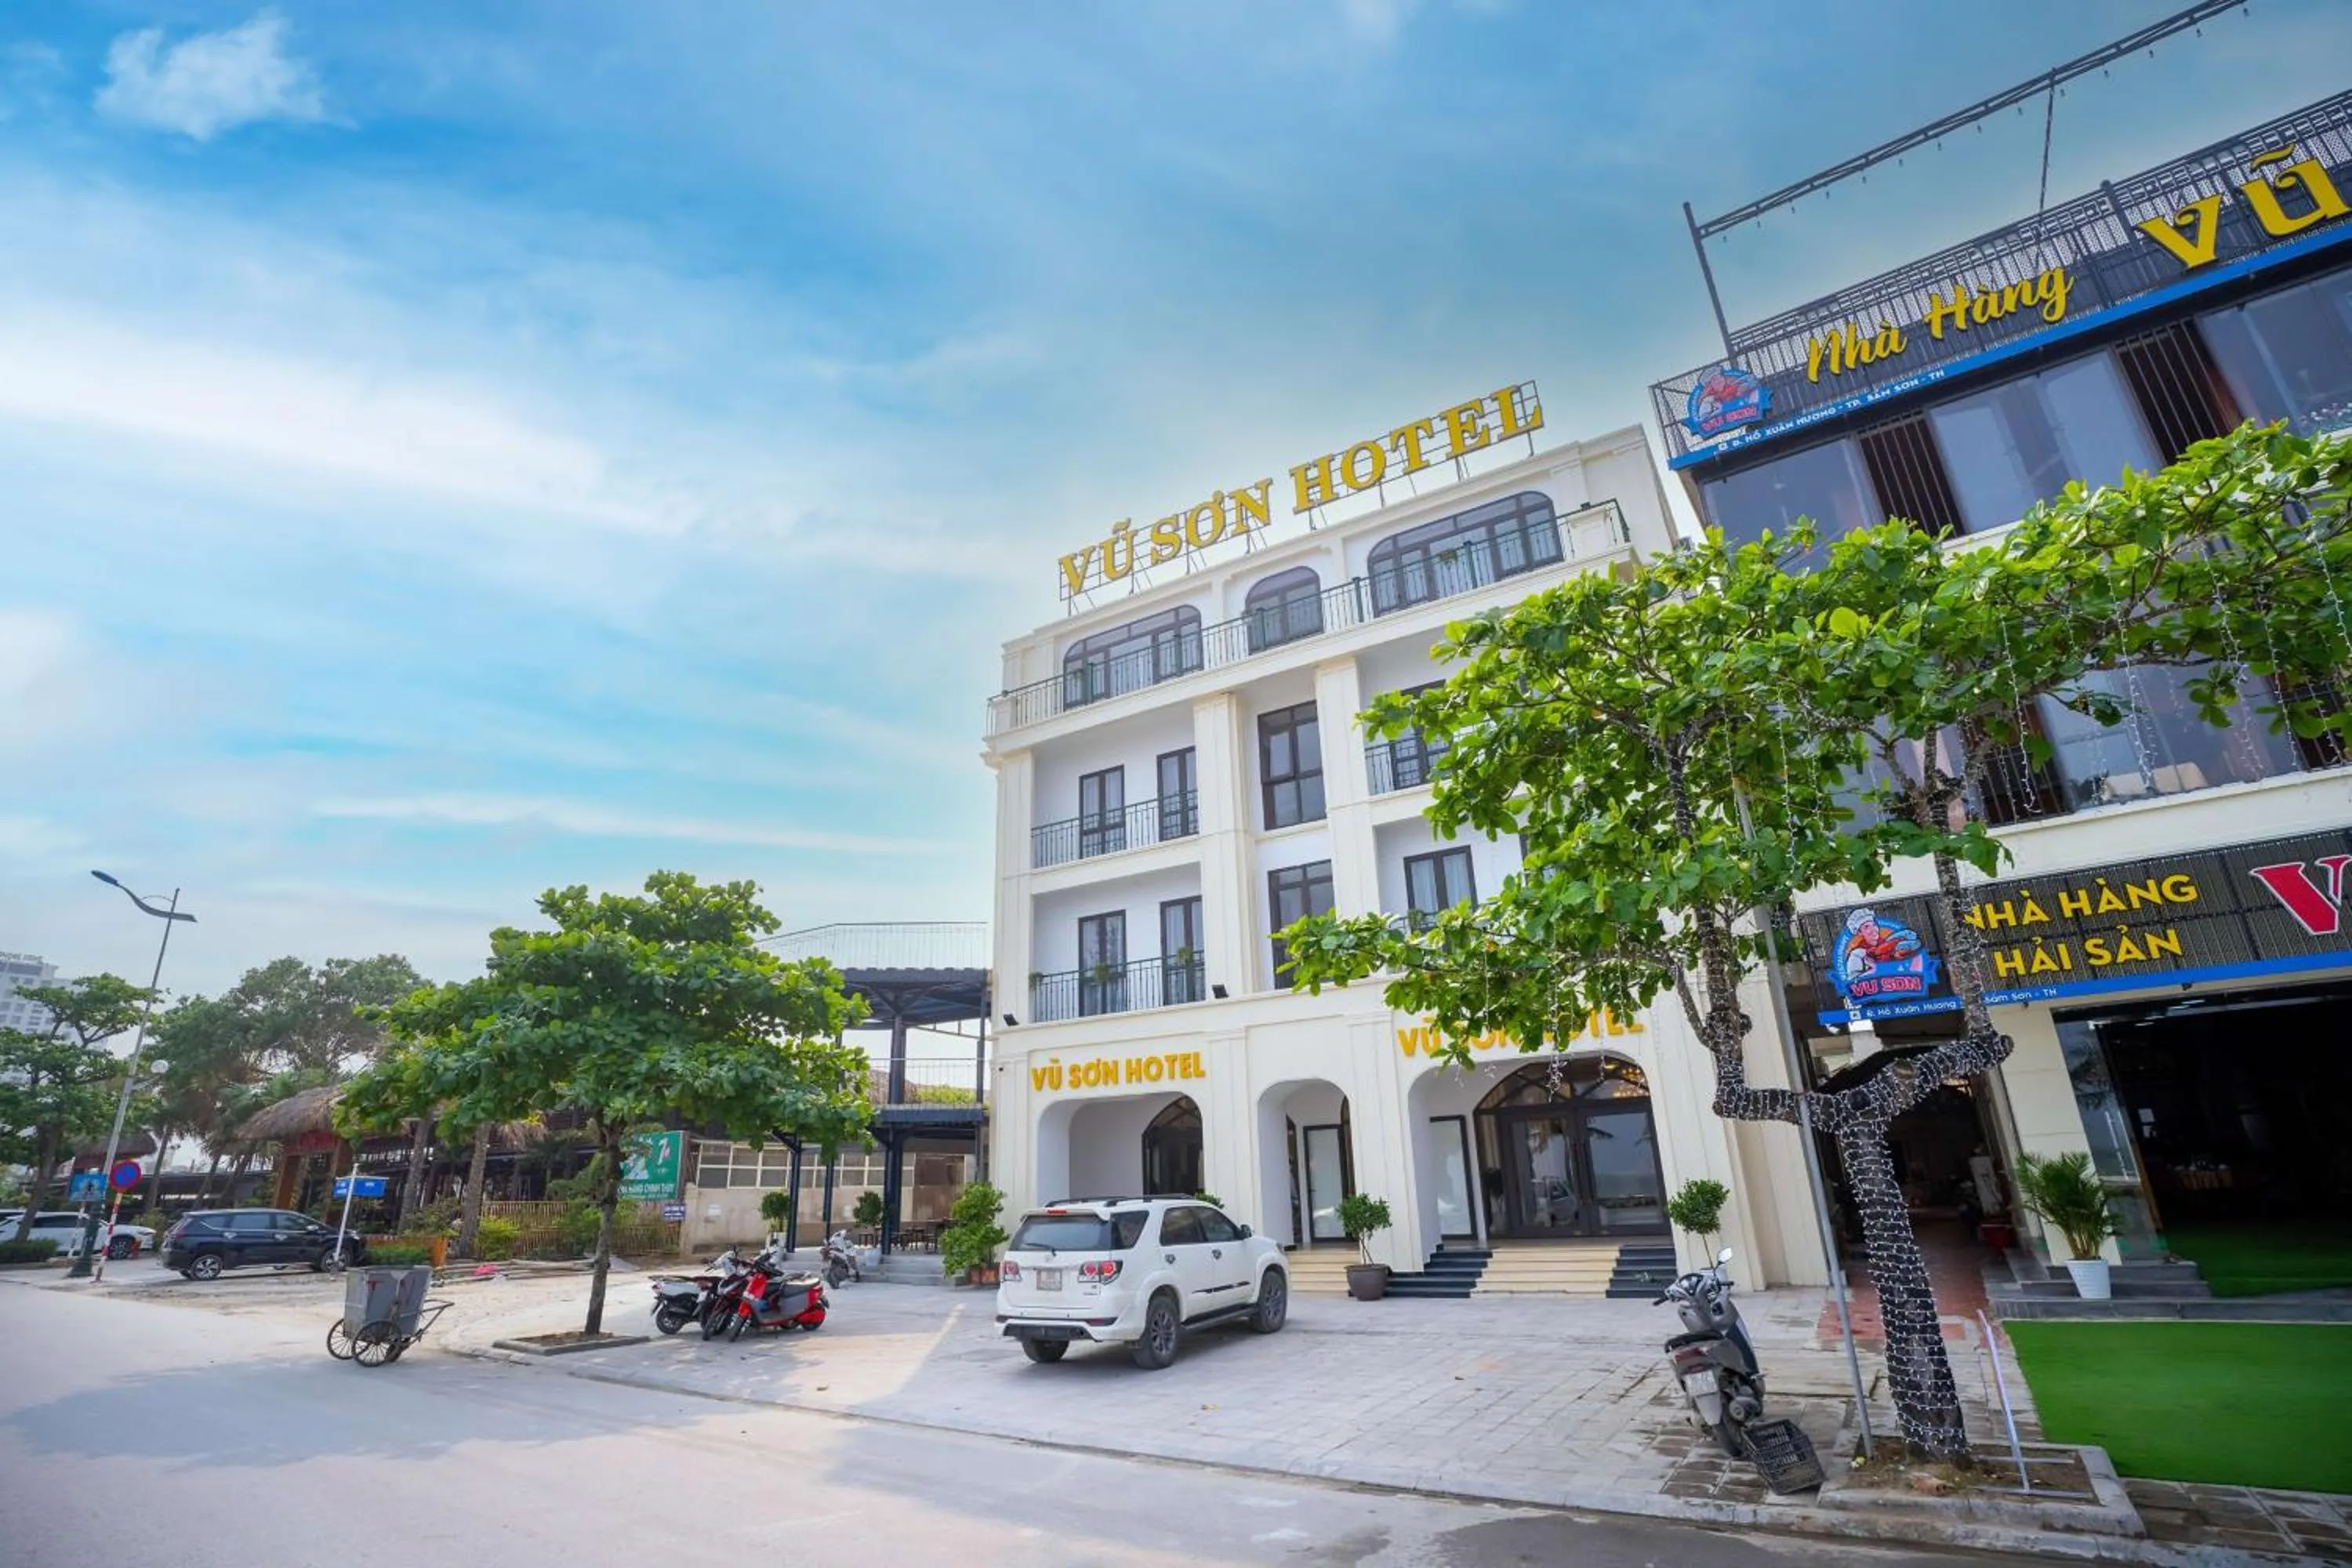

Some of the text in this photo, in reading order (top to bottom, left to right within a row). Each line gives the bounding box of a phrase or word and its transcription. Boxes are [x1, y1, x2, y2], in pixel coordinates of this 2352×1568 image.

[1807, 143, 2352, 383] Nhà Hàng VŨ
[1929, 369, 1945, 380] TH
[1058, 384, 1544, 596] VŨ SƠN HOTEL
[1964, 874, 2198, 930] NHÀ HÀNG
[1994, 925, 2183, 978] HẢI SẢN
[2042, 989, 2057, 997] TH
[1031, 1051, 1206, 1091] VŨ SƠN HOTEL
